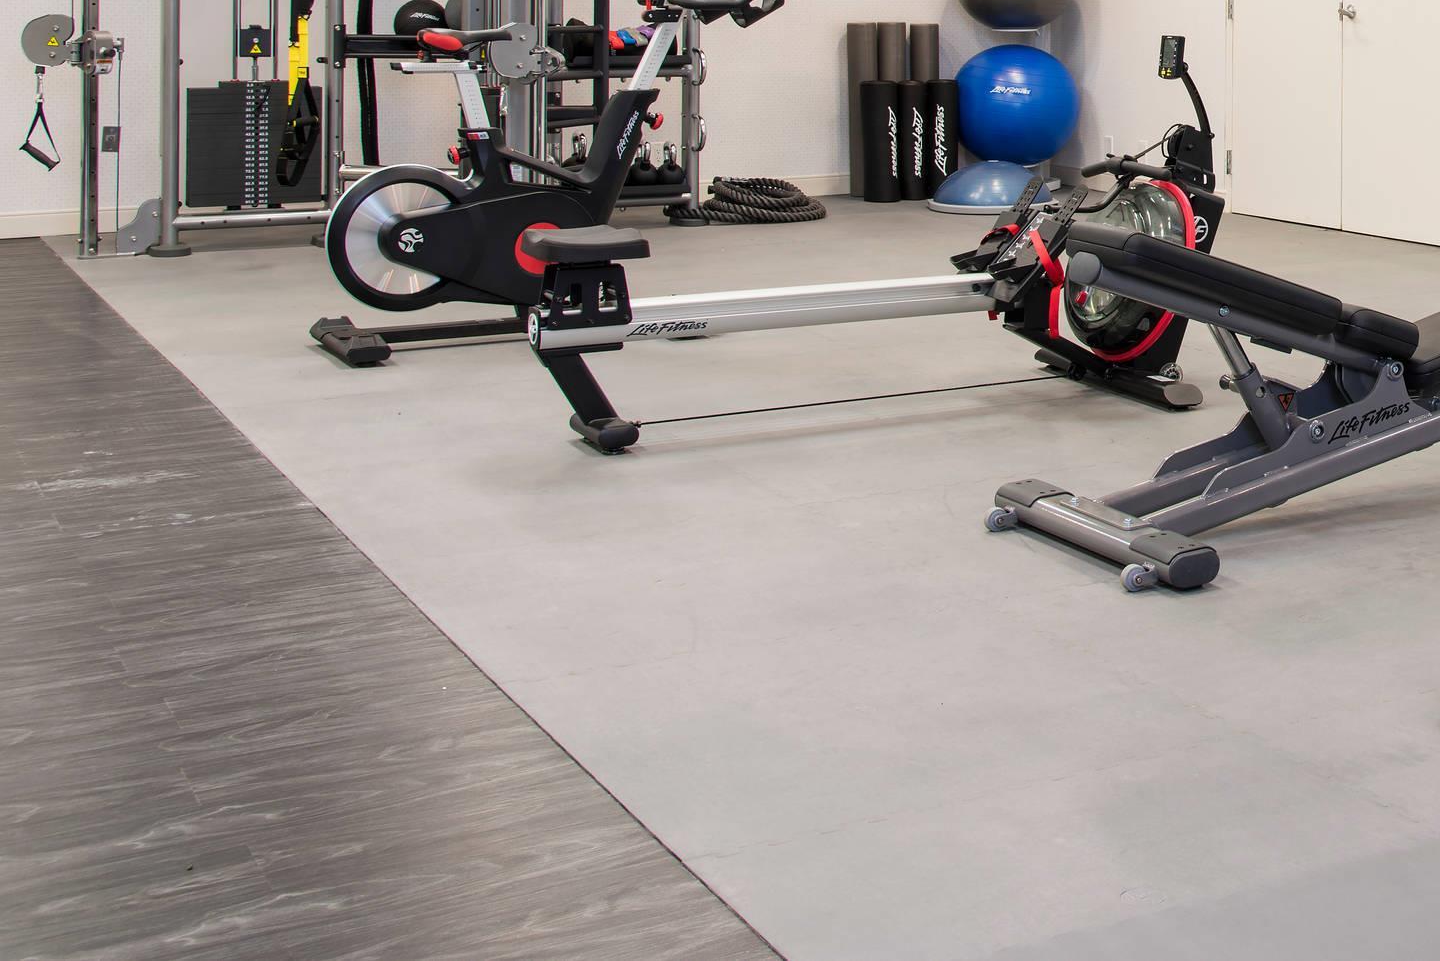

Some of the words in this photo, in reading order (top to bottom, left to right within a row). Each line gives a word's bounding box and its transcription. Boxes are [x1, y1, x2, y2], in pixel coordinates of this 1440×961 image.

[626, 323, 659, 337] Life
[656, 321, 707, 335] Fitness
[1328, 416, 1360, 445] Life
[1358, 402, 1410, 434] Fitness
